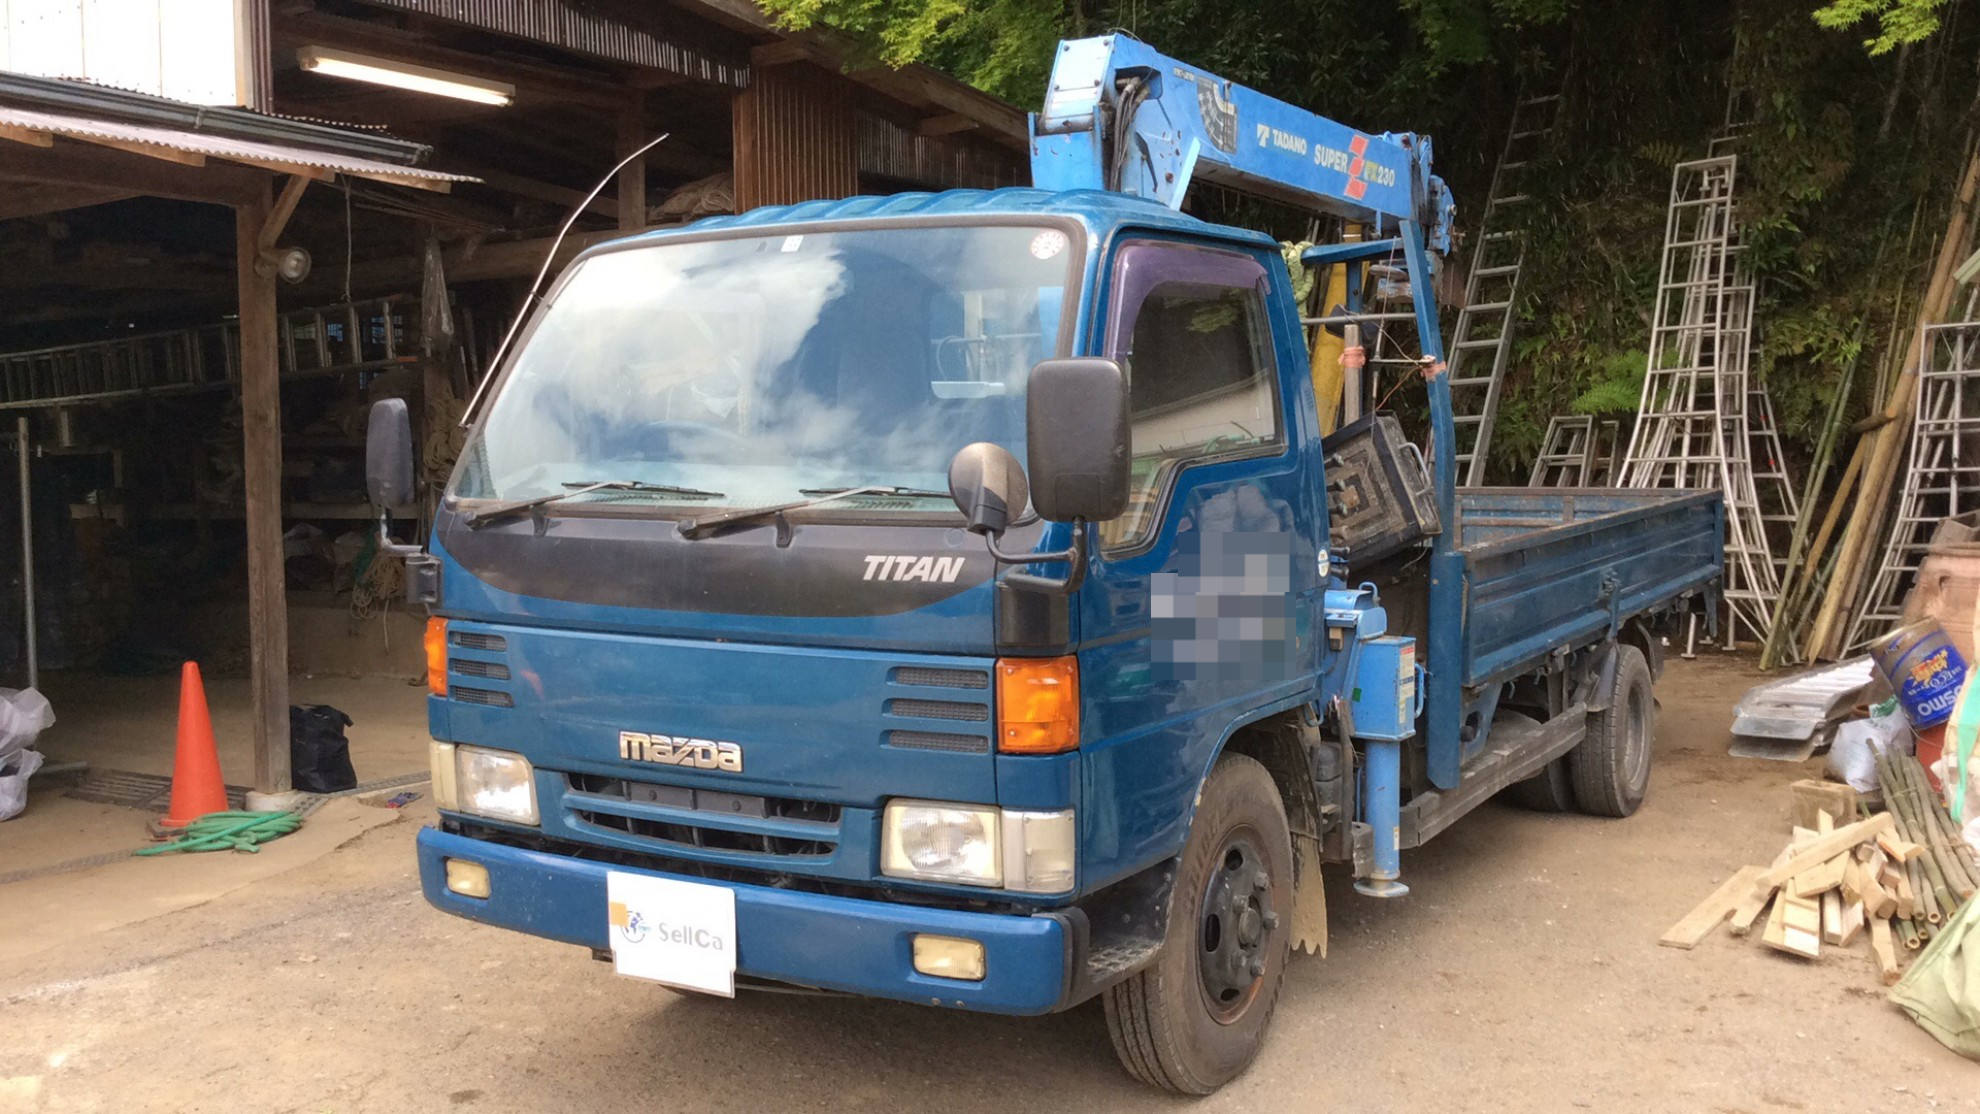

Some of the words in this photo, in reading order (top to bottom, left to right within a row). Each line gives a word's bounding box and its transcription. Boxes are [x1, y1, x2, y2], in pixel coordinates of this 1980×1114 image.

[1272, 129, 1307, 155] TADANO
[1313, 143, 1349, 174] SUPER
[863, 555, 965, 583] TITAN
[658, 922, 723, 950] SellCa
